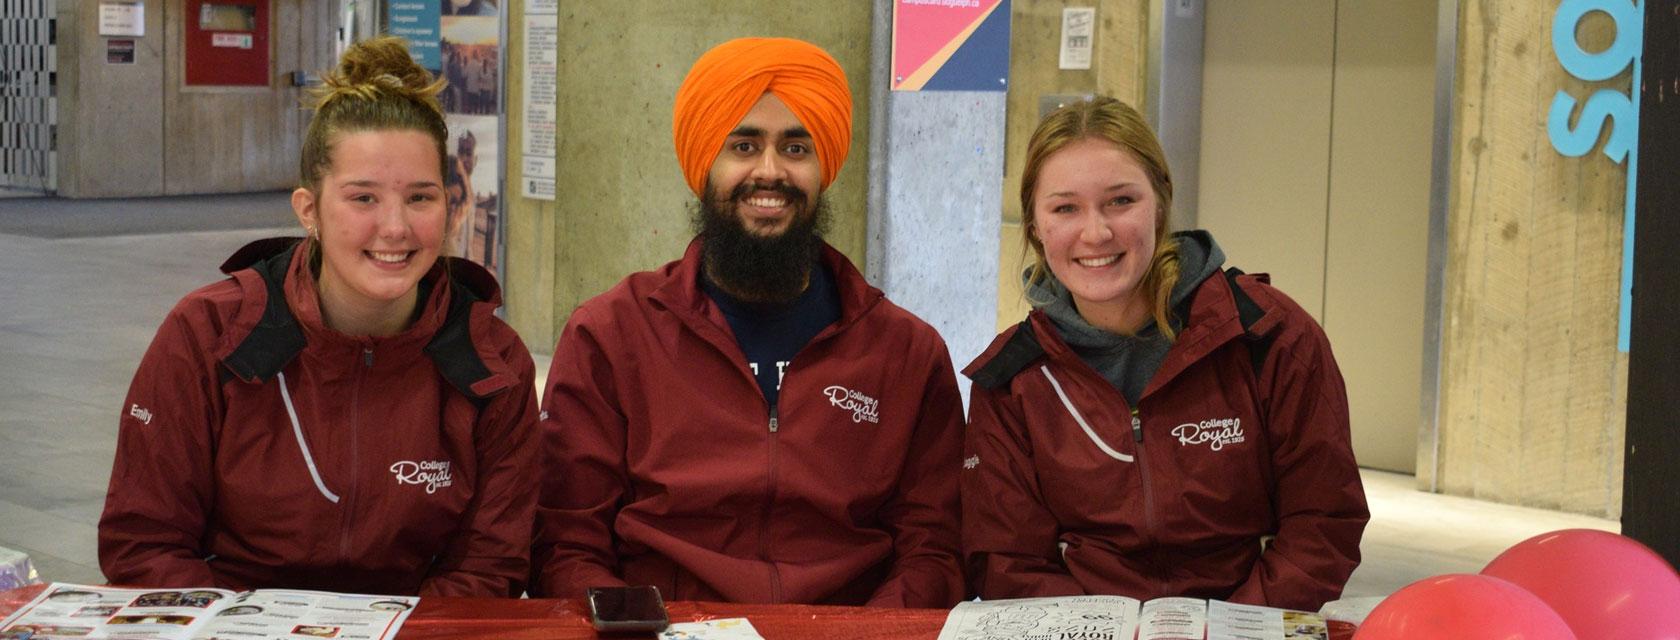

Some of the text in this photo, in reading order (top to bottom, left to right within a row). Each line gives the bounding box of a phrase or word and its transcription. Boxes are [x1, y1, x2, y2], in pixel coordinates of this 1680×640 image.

[130, 403, 152, 425] Emily
[823, 385, 879, 423] Royal
[1171, 417, 1243, 451] Royal
[1200, 418, 1233, 430] College
[389, 460, 451, 494] Royal
